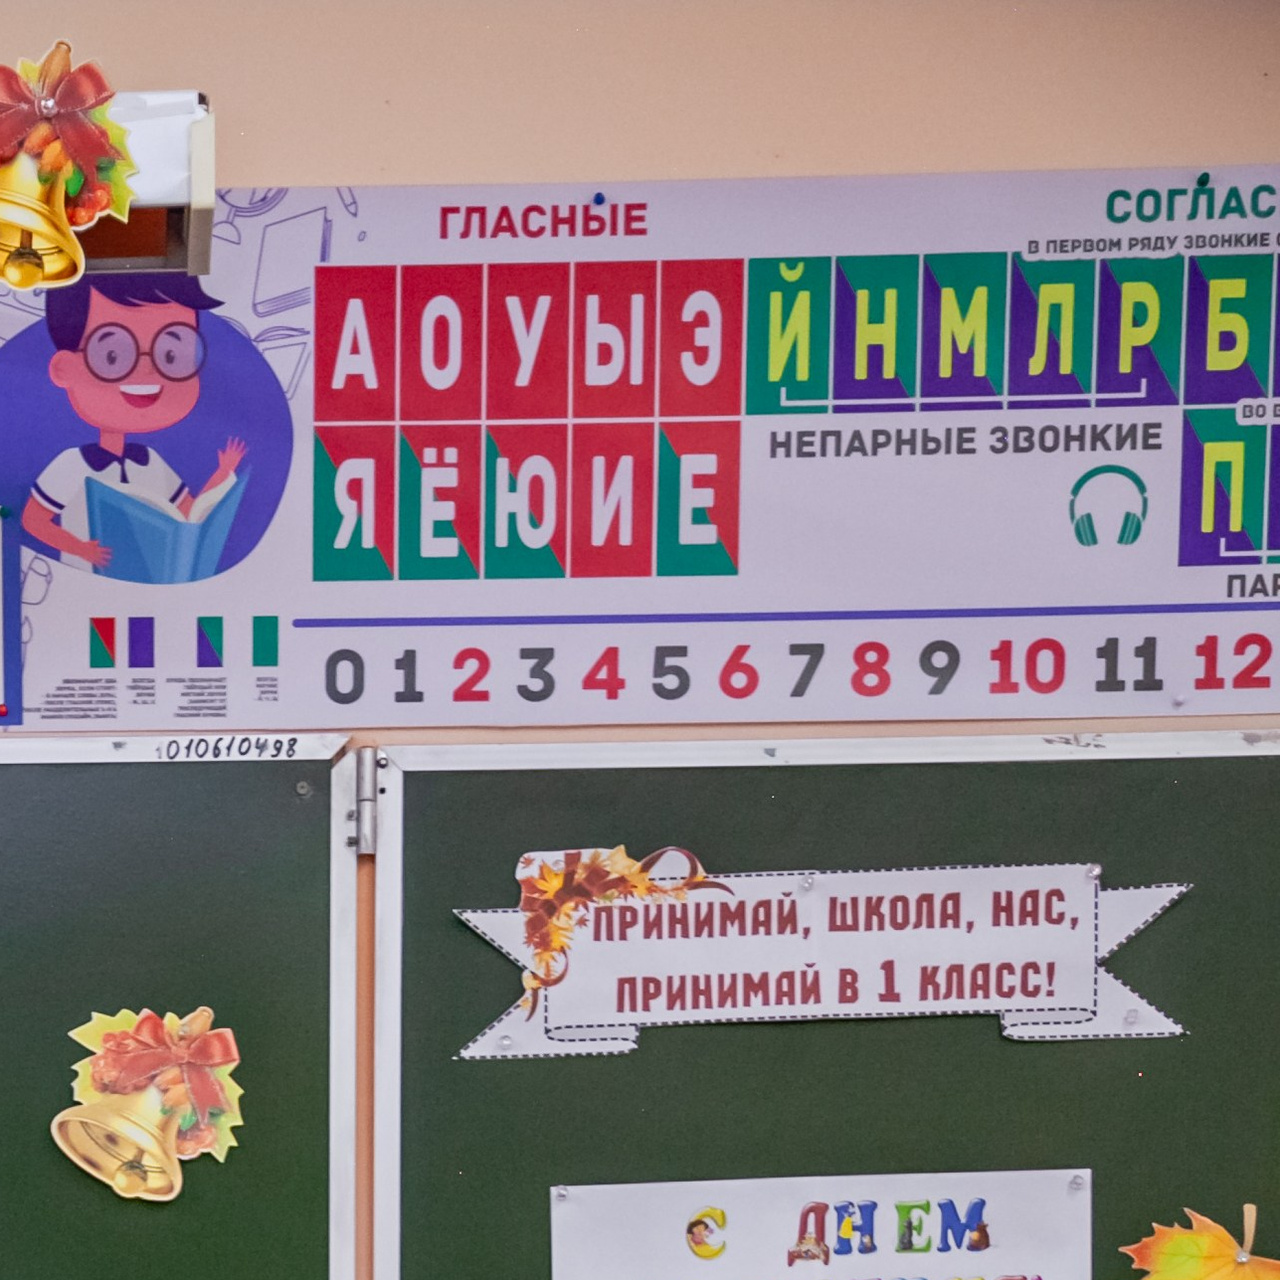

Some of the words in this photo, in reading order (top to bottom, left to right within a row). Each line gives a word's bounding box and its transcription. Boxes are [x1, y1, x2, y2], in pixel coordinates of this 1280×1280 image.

[439, 202, 648, 239] ГЛАСНЫЕ
[1028, 240, 1040, 255] В
[1046, 237, 1122, 254] ПЕРВОМ
[1128, 235, 1178, 252] РЯДУ
[1184, 232, 1270, 249] ЗВОНКИЕ
[331, 298, 379, 390] А
[420, 295, 463, 391] О
[505, 295, 552, 387] У
[585, 293, 644, 386] Ы
[680, 290, 722, 386] Э
[767, 261, 811, 383] Й
[854, 288, 898, 380] Н
[938, 286, 988, 379] М
[1028, 283, 1075, 376] Л
[1118, 281, 1161, 374] Р
[1206, 278, 1250, 372] Б
[770, 427, 977, 459] НЕПАРНЫЕ
[989, 422, 1163, 454] ЗВОНКИЕ
[333, 457, 376, 550] Я
[420, 447, 460, 558] Ё
[494, 454, 558, 550] Ю
[591, 454, 634, 547] И
[678, 453, 719, 545] Е
[1200, 441, 1246, 533] П
[324, 648, 366, 705] 0
[393, 648, 425, 703] 1
[451, 647, 491, 702] 2
[516, 647, 556, 702] 3
[581, 645, 626, 700] 4
[651, 645, 691, 700] 5
[718, 644, 760, 700] 6
[788, 643, 826, 698] 7
[850, 640, 892, 698] 8
[920, 639, 961, 696] 9
[988, 637, 1067, 694] 10
[1095, 636, 1164, 692] 11
[1194, 632, 1273, 690] 12
[591, 890, 811, 943] ПРИНИМАЙ,
[827, 885, 974, 935] ШКОЛА,
[991, 887, 1079, 933] НАС,
[615, 962, 821, 1014] ПРИНИМАЙ
[838, 968, 860, 1005] В
[879, 959, 901, 1004] 1
[919, 962, 1057, 1001] КЛАСС!
[685, 1206, 728, 1260] С
[786, 1197, 996, 1268] ДНЕМ
